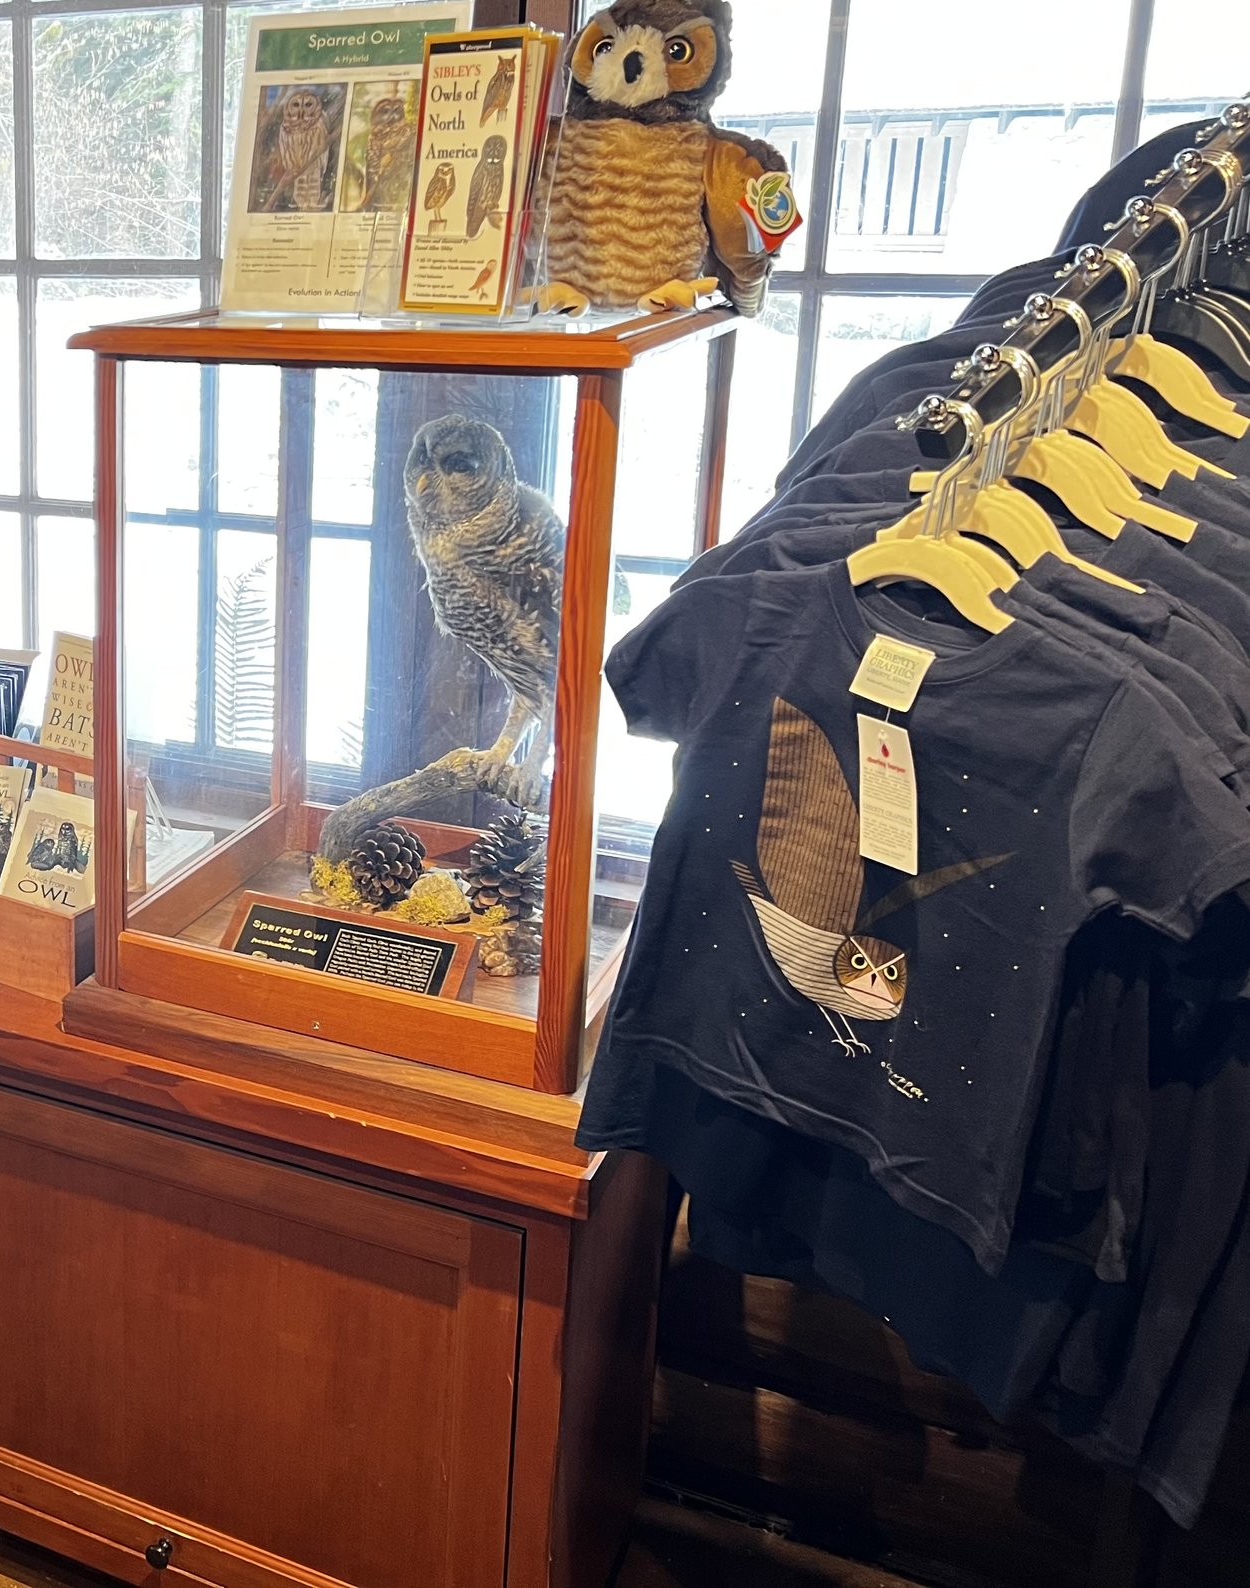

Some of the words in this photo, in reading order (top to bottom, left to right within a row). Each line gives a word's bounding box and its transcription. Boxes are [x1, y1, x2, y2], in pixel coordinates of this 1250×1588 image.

[308, 32, 365, 50] Sparred
[370, 29, 400, 44] Owl
[334, 56, 341, 64] A
[342, 54, 370, 64] Hybrid
[433, 64, 481, 79] SIBLEY'S
[430, 81, 462, 103] Owls
[465, 80, 480, 101] of
[428, 109, 465, 131] North
[425, 142, 478, 160] America
[288, 288, 322, 296] Evolution
[324, 288, 332, 296] in
[333, 288, 362, 297] Action!
[55, 653, 94, 682] OWL
[870, 656, 915, 680] GRAPHICS
[876, 649, 914, 669] LIBERTY
[52, 677, 94, 694] AREN'
[51, 691, 82, 709] WISE
[45, 732, 89, 752] AREN'T
[25, 872, 48, 886] Advice
[50, 877, 65, 890] from
[18, 879, 76, 908] OWL
[252, 919, 301, 936] Sparred
[303, 930, 328, 942] Owl
